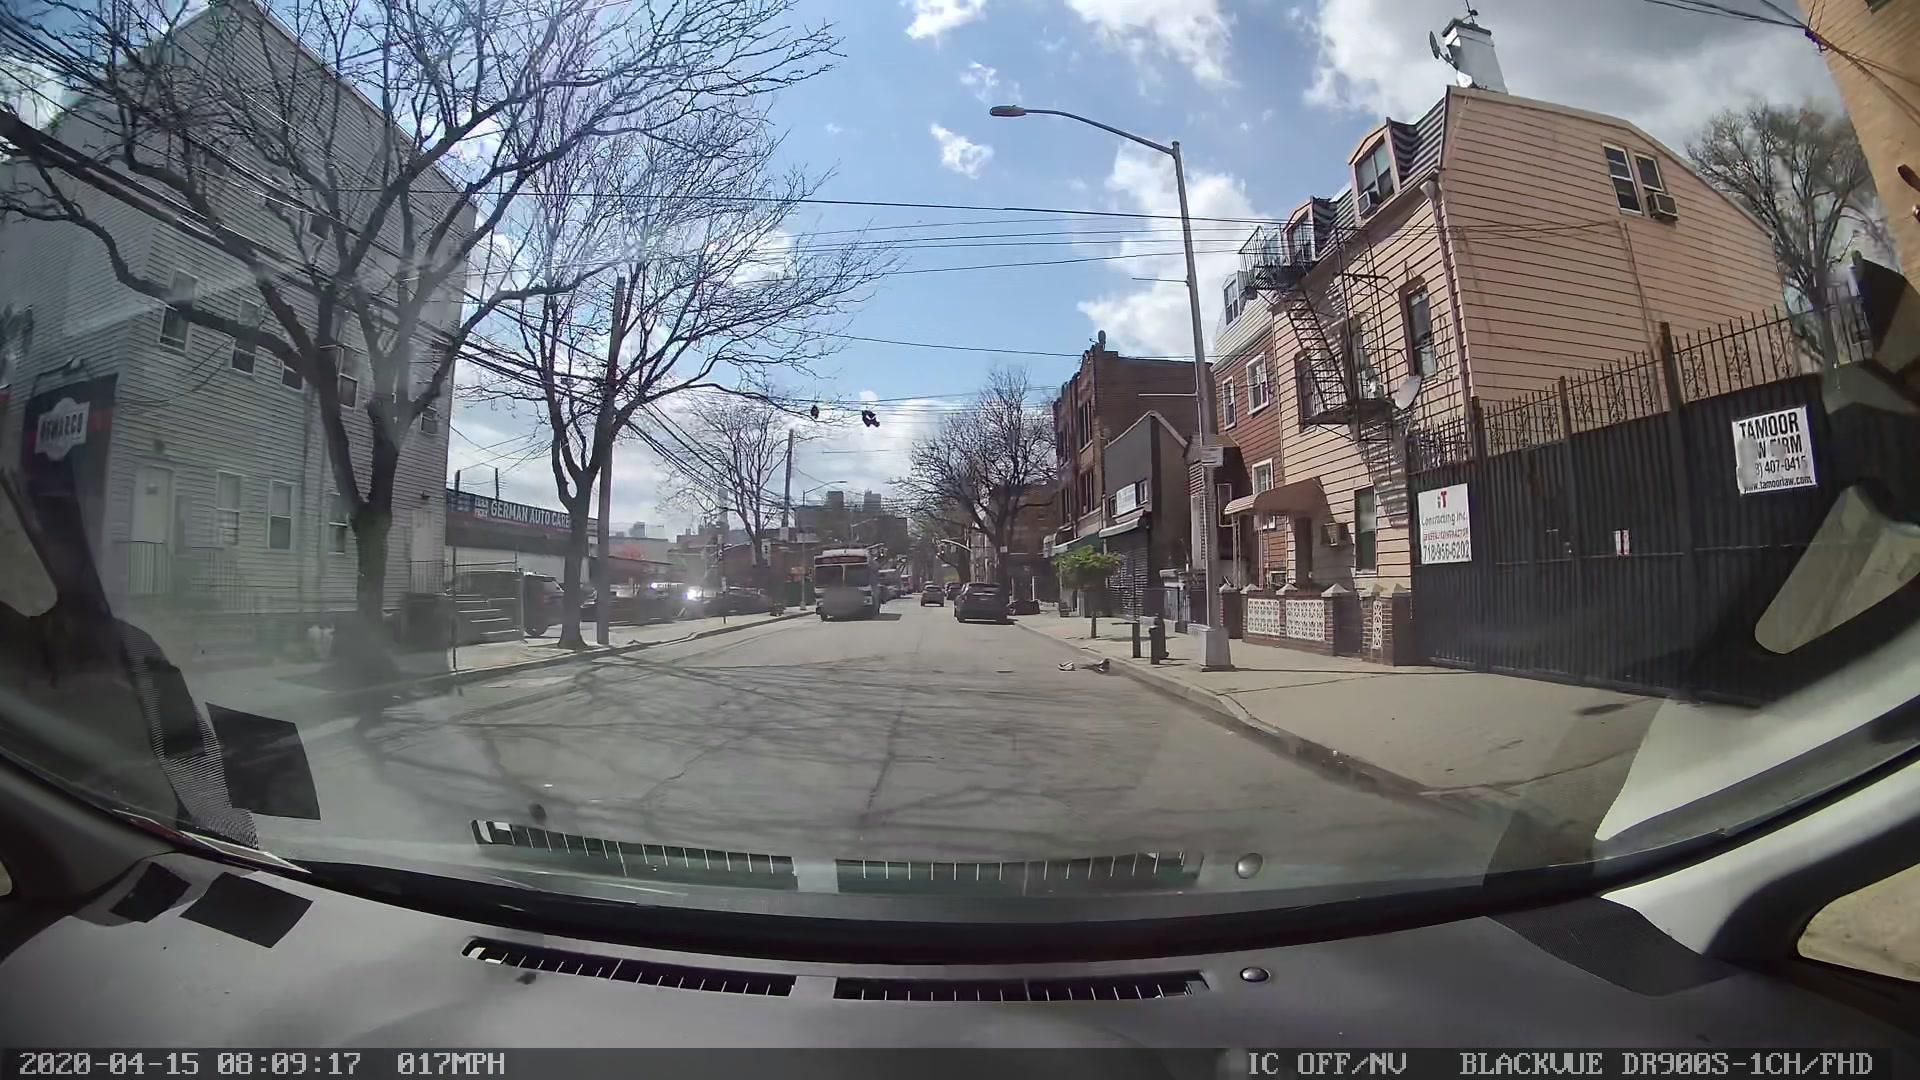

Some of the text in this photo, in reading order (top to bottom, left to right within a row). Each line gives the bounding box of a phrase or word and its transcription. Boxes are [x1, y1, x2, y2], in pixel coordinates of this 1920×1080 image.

[1739, 412, 1800, 440] TAMOOR
[490, 501, 528, 522] GERMAN
[529, 508, 551, 526] AUTO
[551, 513, 570, 529] CARE
